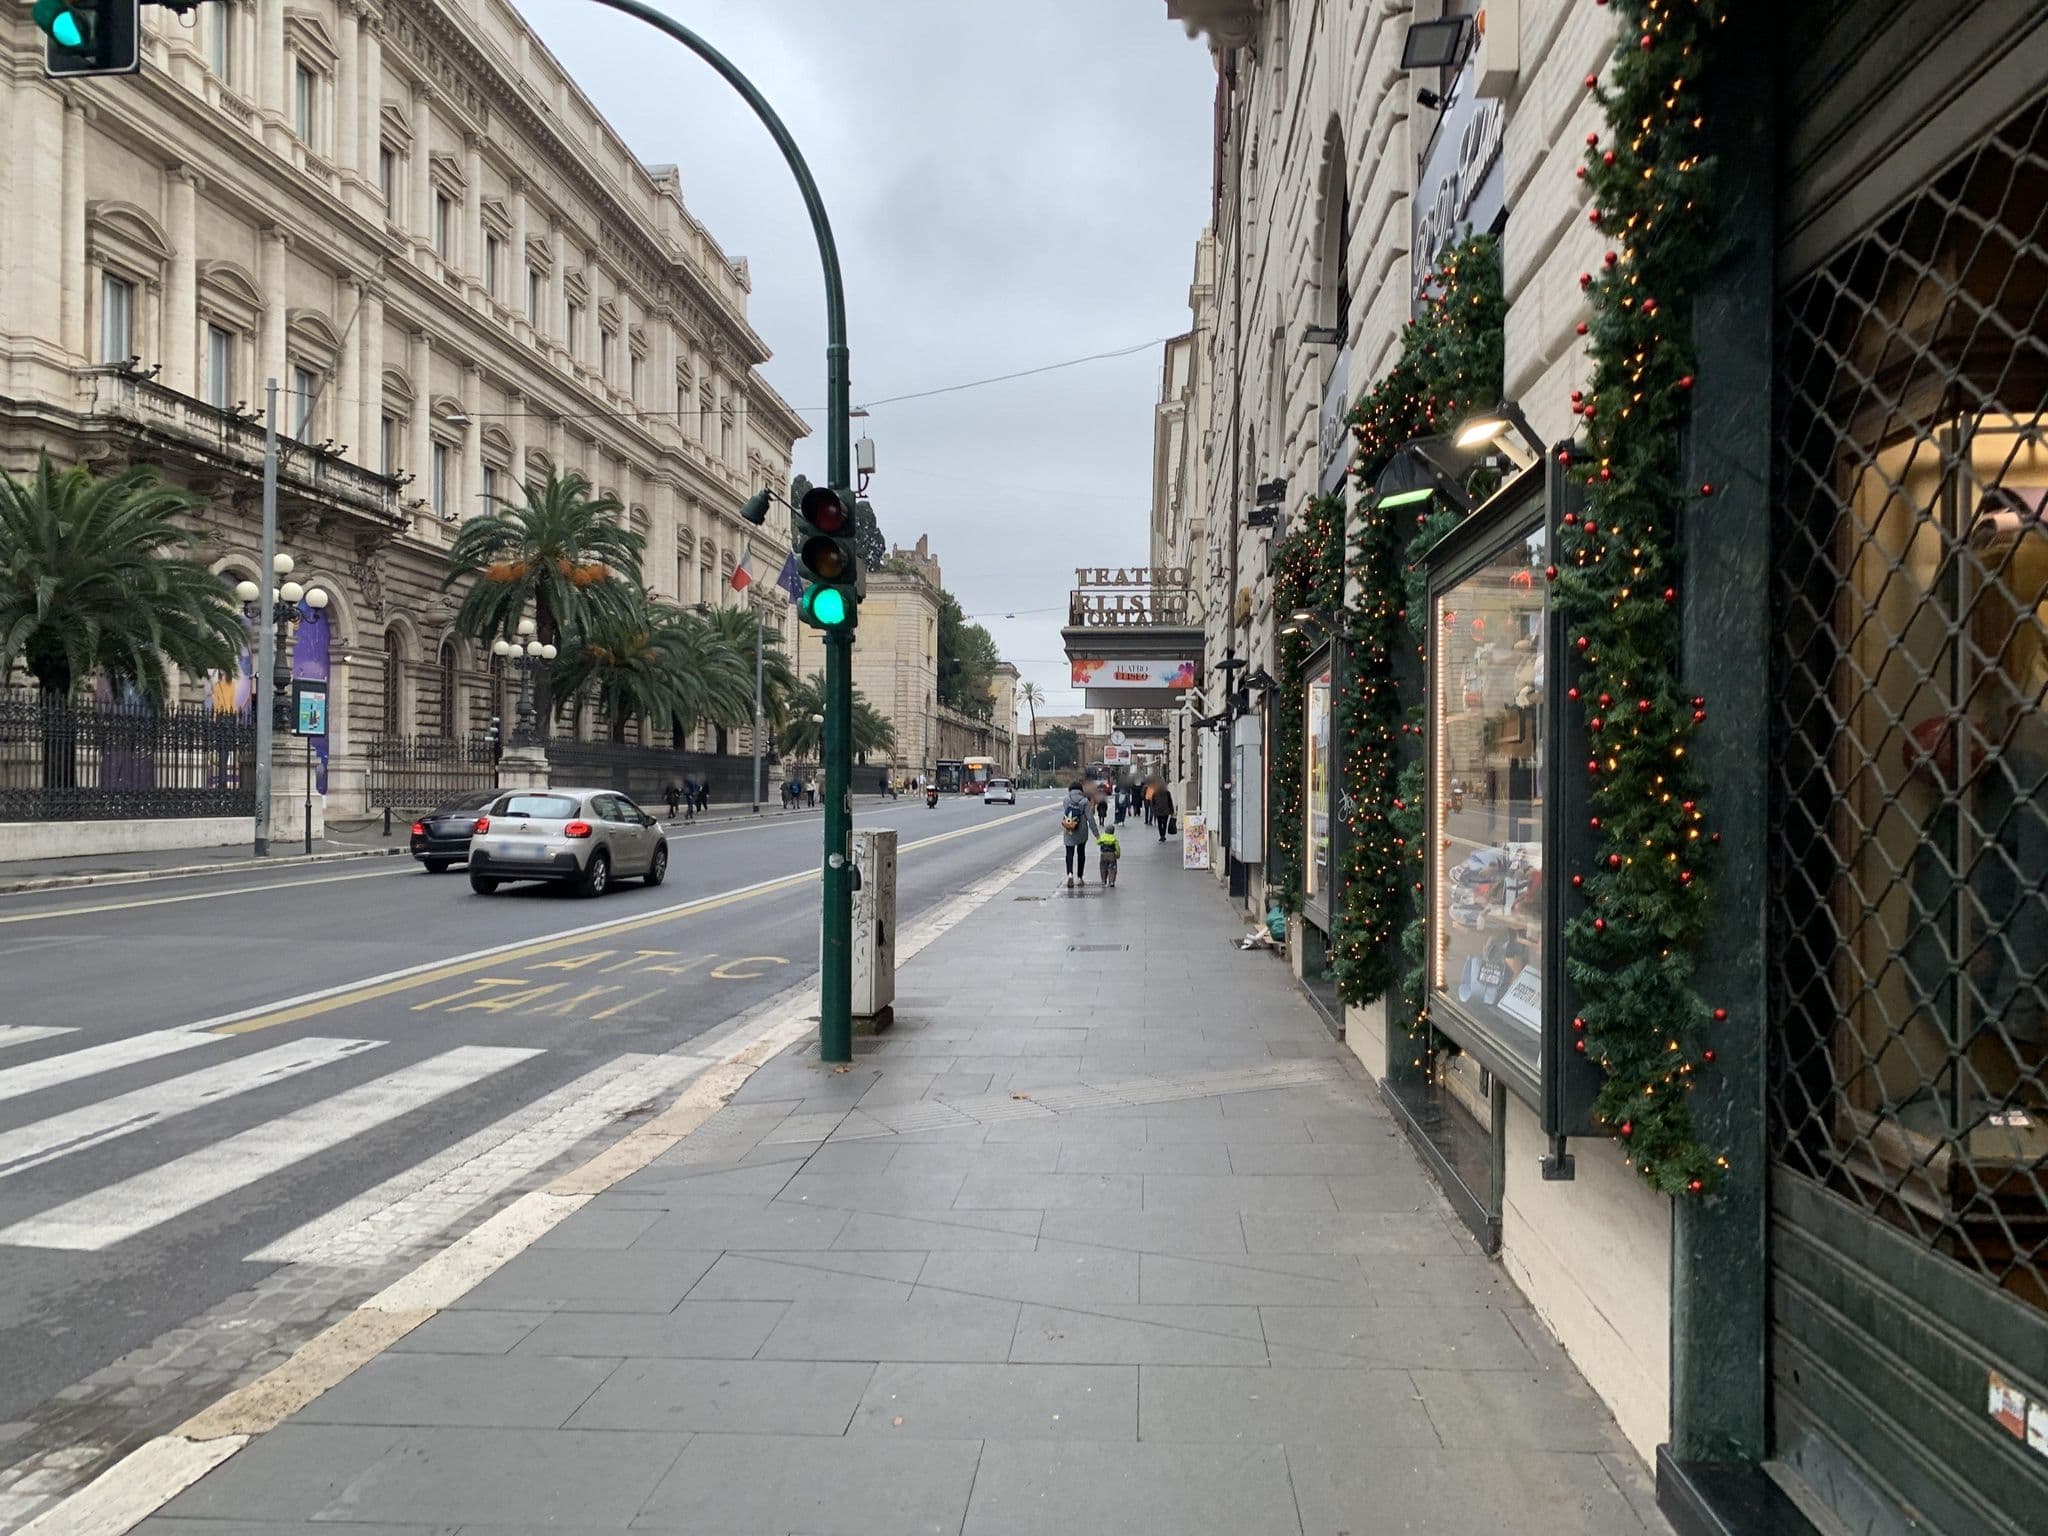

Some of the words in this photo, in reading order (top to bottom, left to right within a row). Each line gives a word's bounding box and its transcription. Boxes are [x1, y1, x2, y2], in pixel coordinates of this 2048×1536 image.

[1075, 567, 1187, 586] TEATRO
[1074, 595, 1188, 614] ELISEO
[1115, 672, 1149, 681] ELISEO
[408, 977, 666, 1020] TAXI
